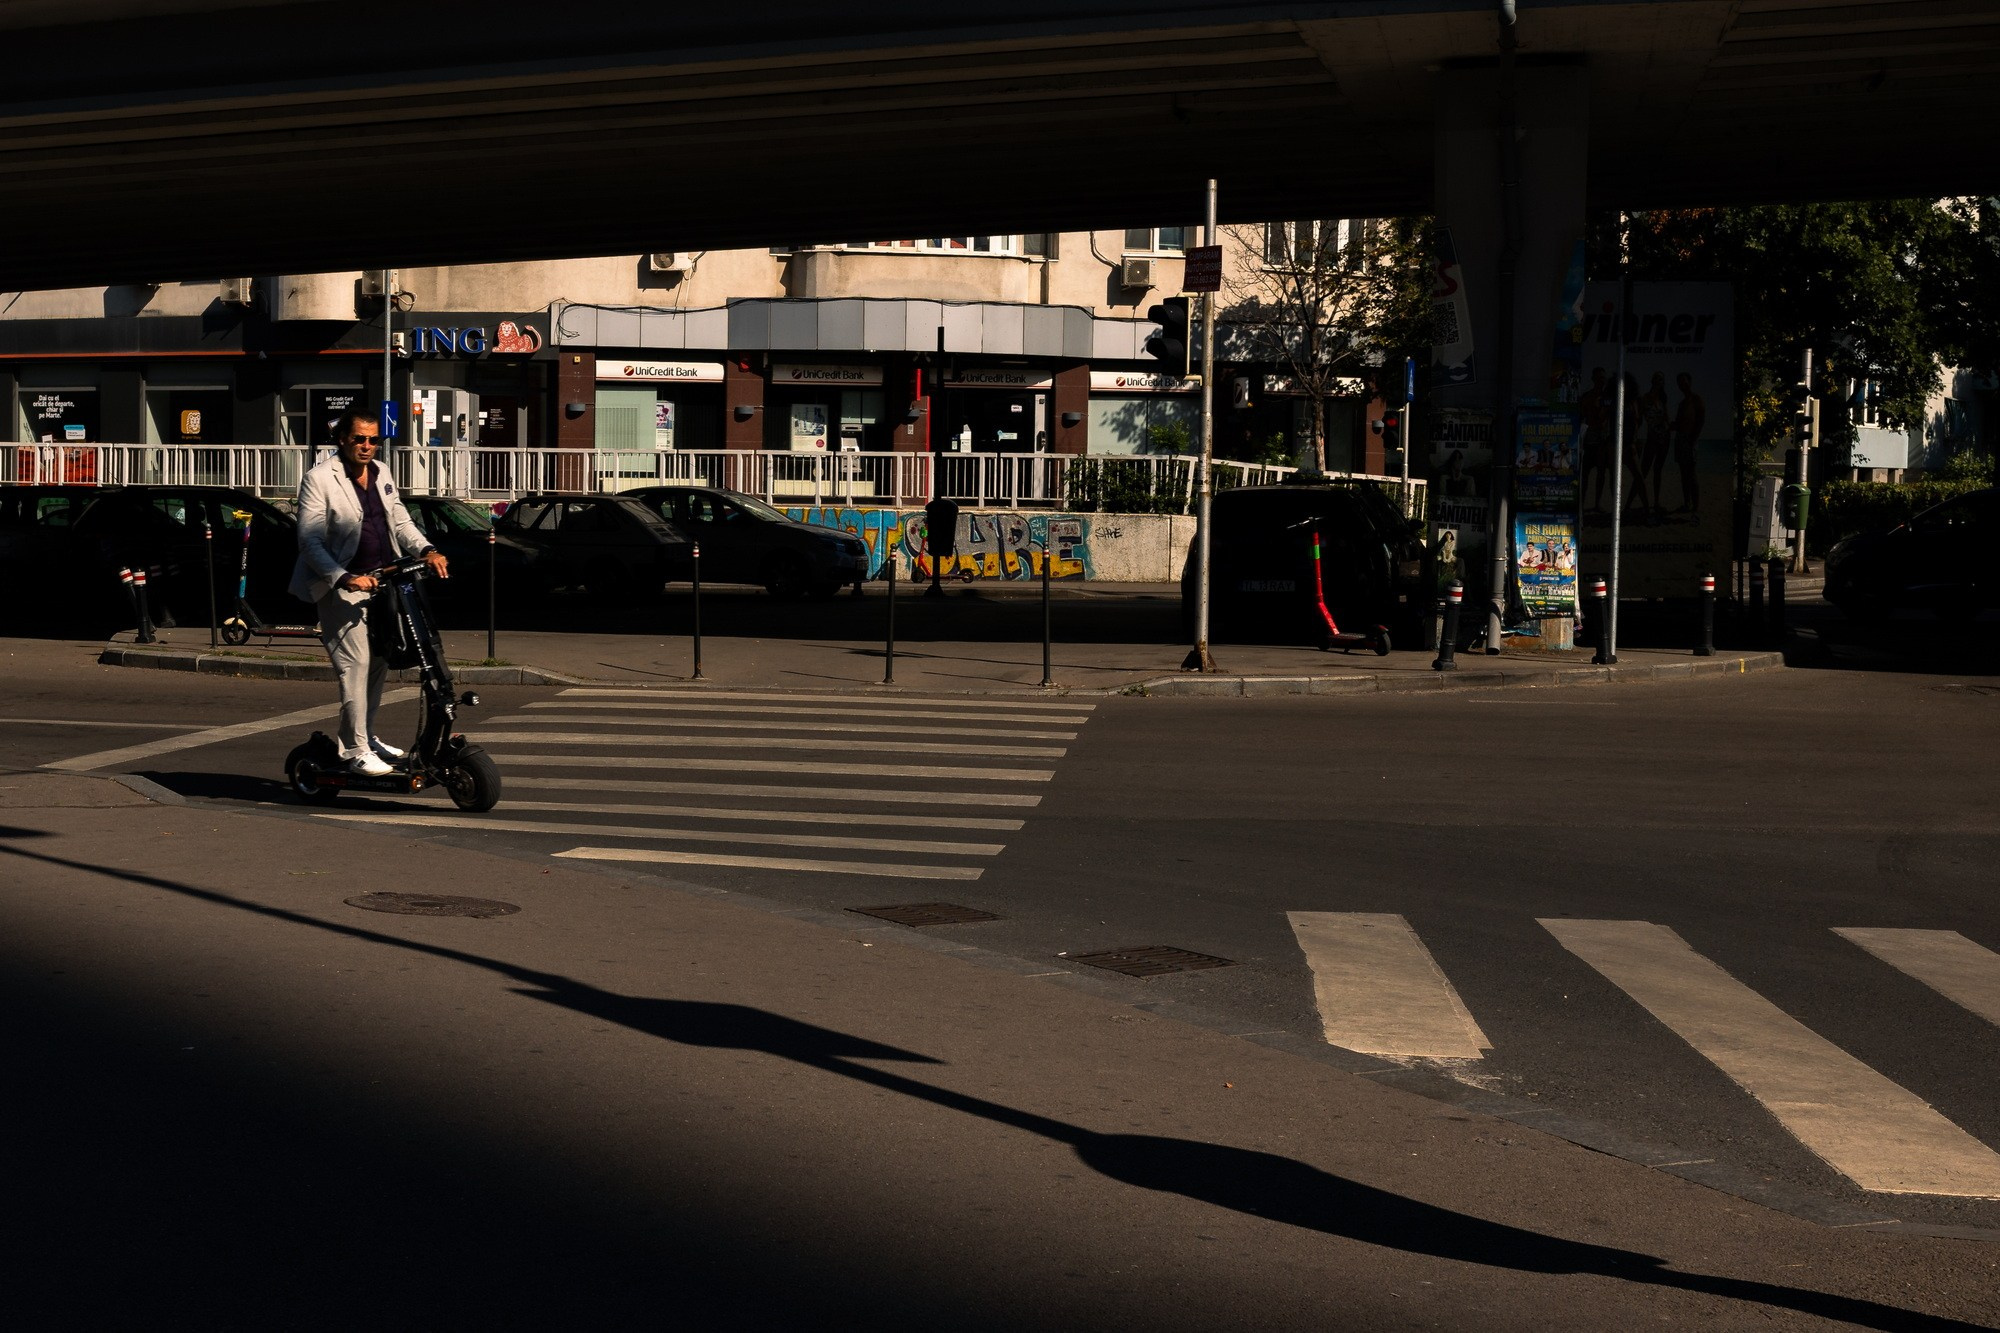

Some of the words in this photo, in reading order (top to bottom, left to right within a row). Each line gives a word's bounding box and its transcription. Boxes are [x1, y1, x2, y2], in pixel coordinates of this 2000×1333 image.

[413, 327, 487, 354] ING
[635, 366, 675, 377] UniCredit
[676, 366, 698, 378] Bank
[803, 369, 842, 380] UniCredit
[843, 370, 865, 380] Bank
[966, 373, 1004, 383] UniCredit
[1005, 373, 1027, 383] Bank
[1126, 377, 1163, 388] UniCredit
